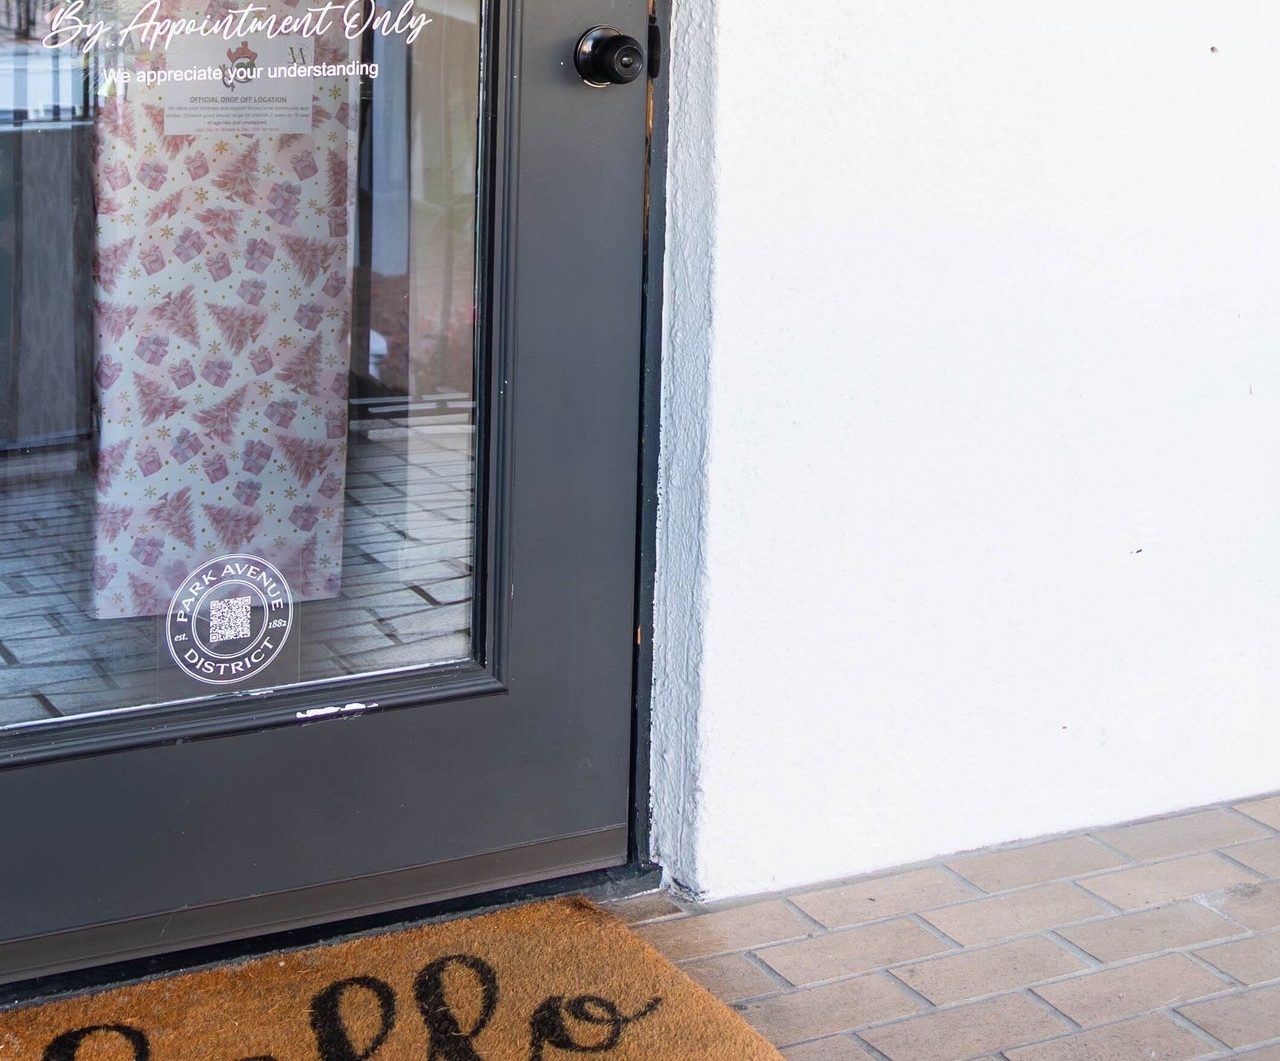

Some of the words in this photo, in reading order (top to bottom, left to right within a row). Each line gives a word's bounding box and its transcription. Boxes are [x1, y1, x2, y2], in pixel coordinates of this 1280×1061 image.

[102, 66, 131, 84] We
[136, 65, 223, 87] appreciate
[226, 64, 265, 87] your
[267, 59, 379, 82] understanding
[189, 96, 219, 104] OFFICIAL
[220, 96, 239, 104] DROP
[254, 96, 287, 104] LOCATION
[176, 570, 218, 623] PARK
[221, 563, 284, 611] AVENUE
[268, 618, 287, 629] 1882
[174, 633, 189, 642] est.
[183, 636, 274, 676] DISTRICT
